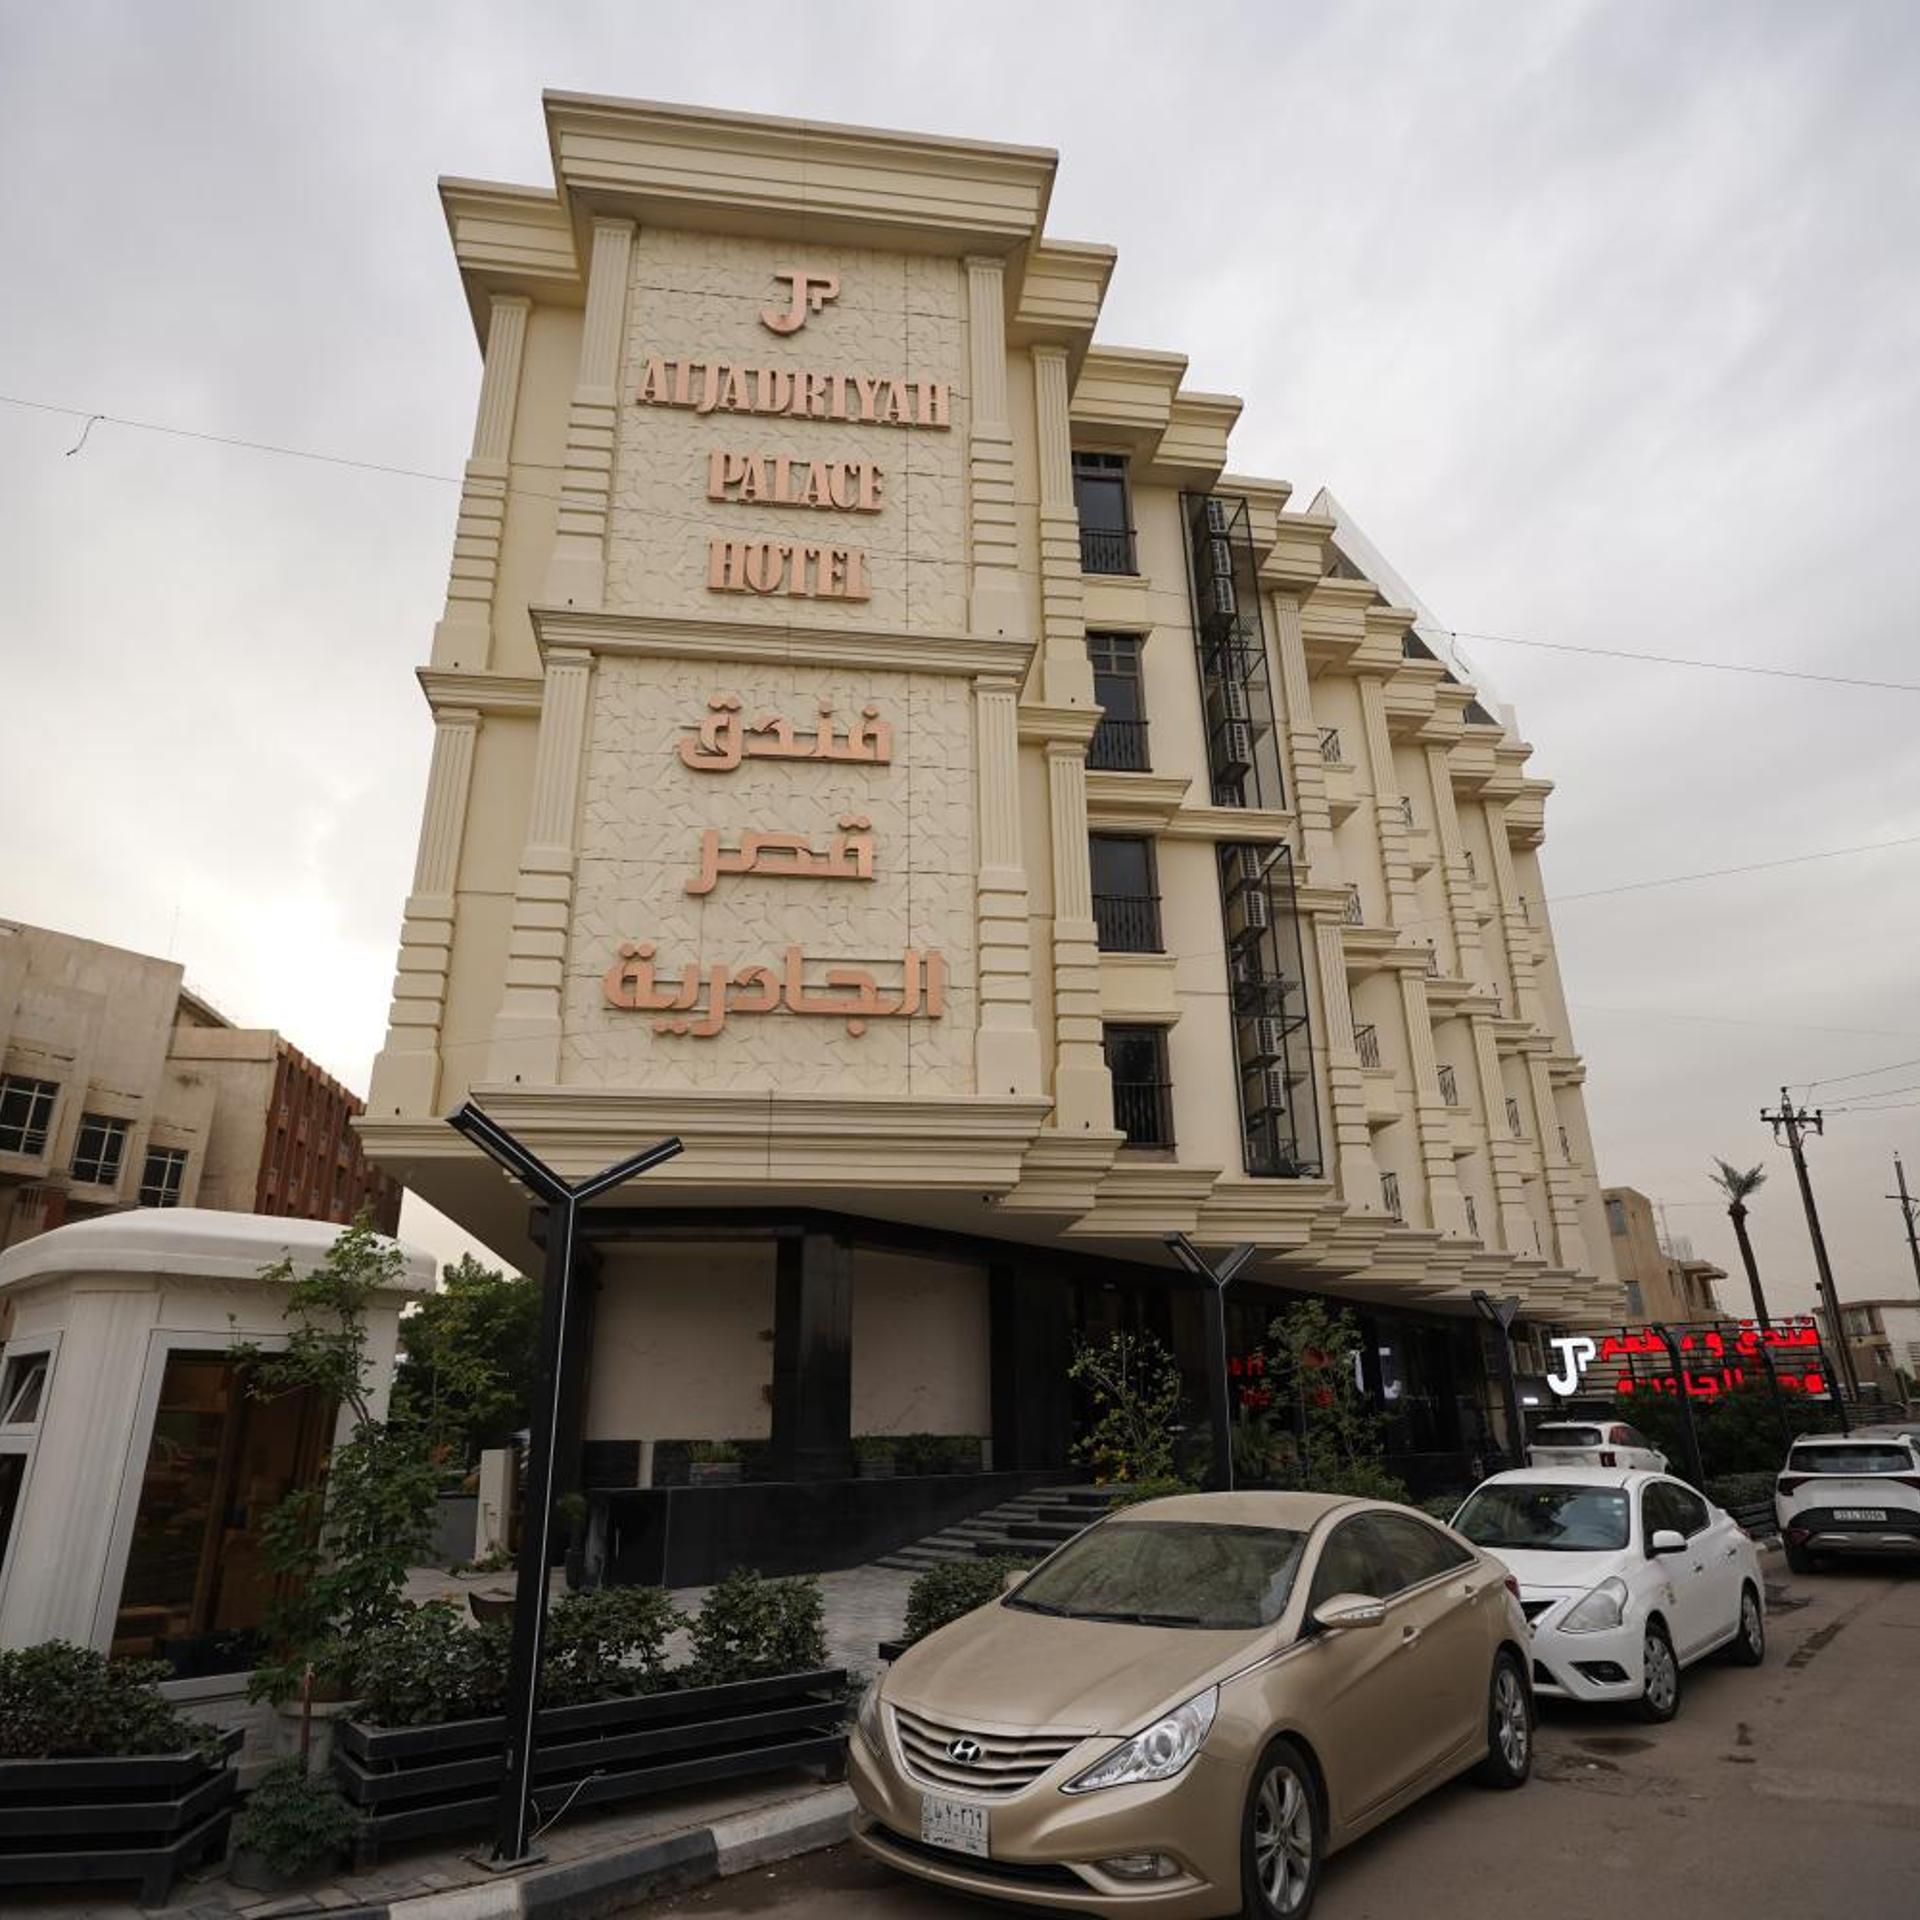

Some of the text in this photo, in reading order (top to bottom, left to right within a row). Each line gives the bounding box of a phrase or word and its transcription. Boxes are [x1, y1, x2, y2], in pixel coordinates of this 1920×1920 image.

[637, 355, 951, 431] ALJADRIYAH
[707, 448, 883, 514] PALACE
[707, 539, 870, 602] HOTEL
[679, 695, 895, 771] فندق
[685, 815, 876, 897] قصر
[602, 940, 945, 1037] الجادرية
